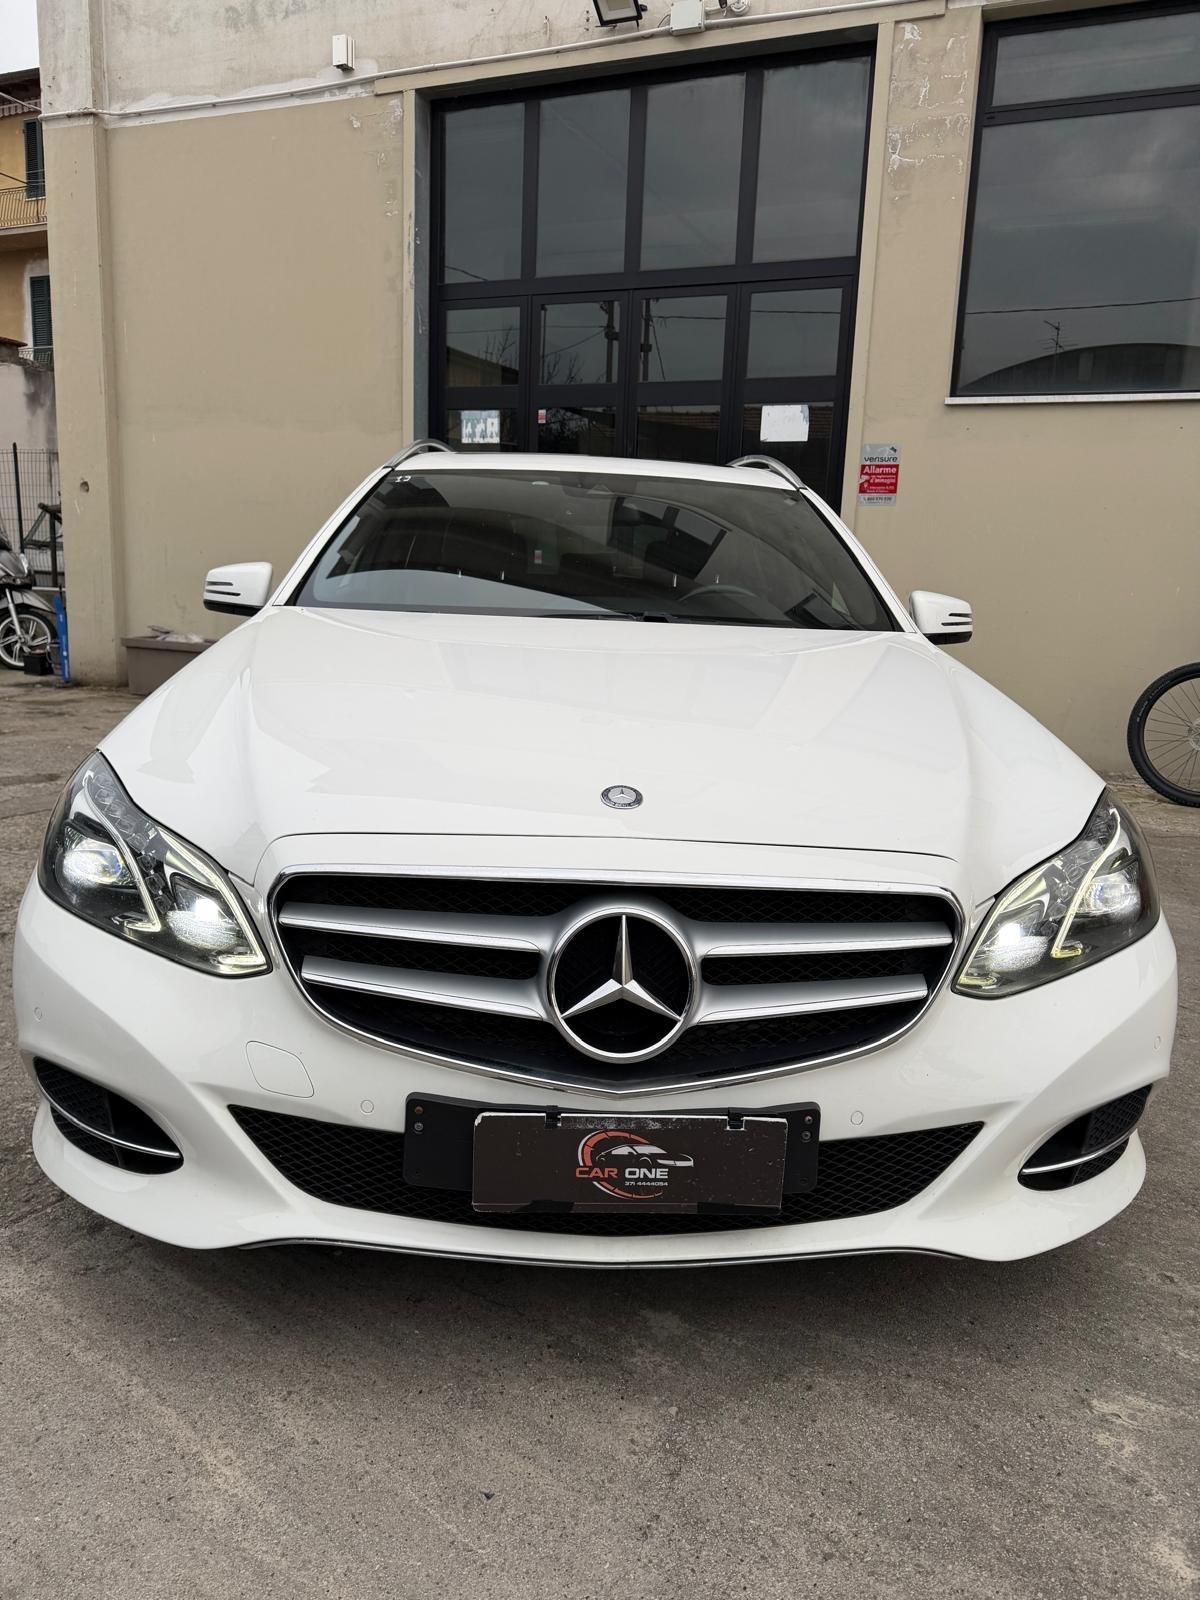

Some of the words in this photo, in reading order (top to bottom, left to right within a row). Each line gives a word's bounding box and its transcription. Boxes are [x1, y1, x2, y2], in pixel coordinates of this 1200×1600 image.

[863, 465, 897, 473] Allarme
[576, 1168, 618, 1178] CAR
[625, 1168, 668, 1178] ONE
